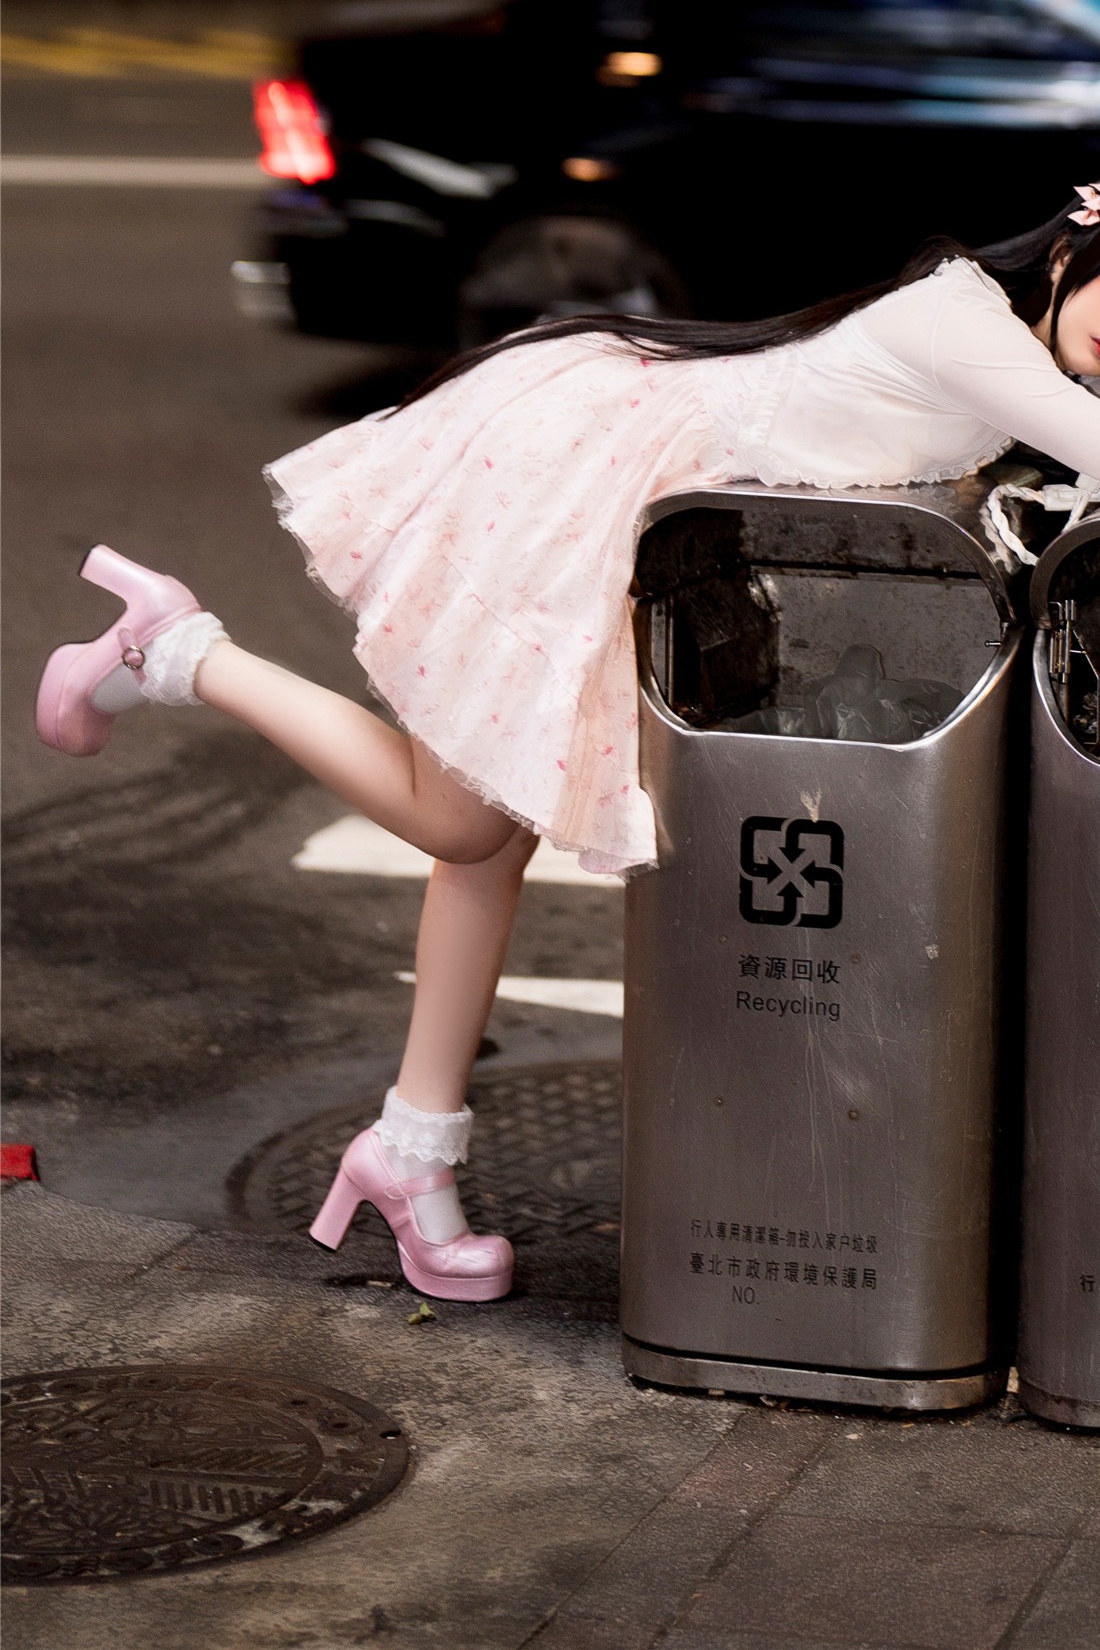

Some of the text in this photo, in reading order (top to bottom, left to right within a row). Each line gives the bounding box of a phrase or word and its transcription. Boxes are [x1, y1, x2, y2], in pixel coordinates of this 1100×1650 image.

[738, 954, 841, 984] 資源回收
[736, 990, 840, 1021] Recycling
[690, 1251, 878, 1290] 臺北市政府環境保護局
[731, 1285, 760, 1305] NO.
